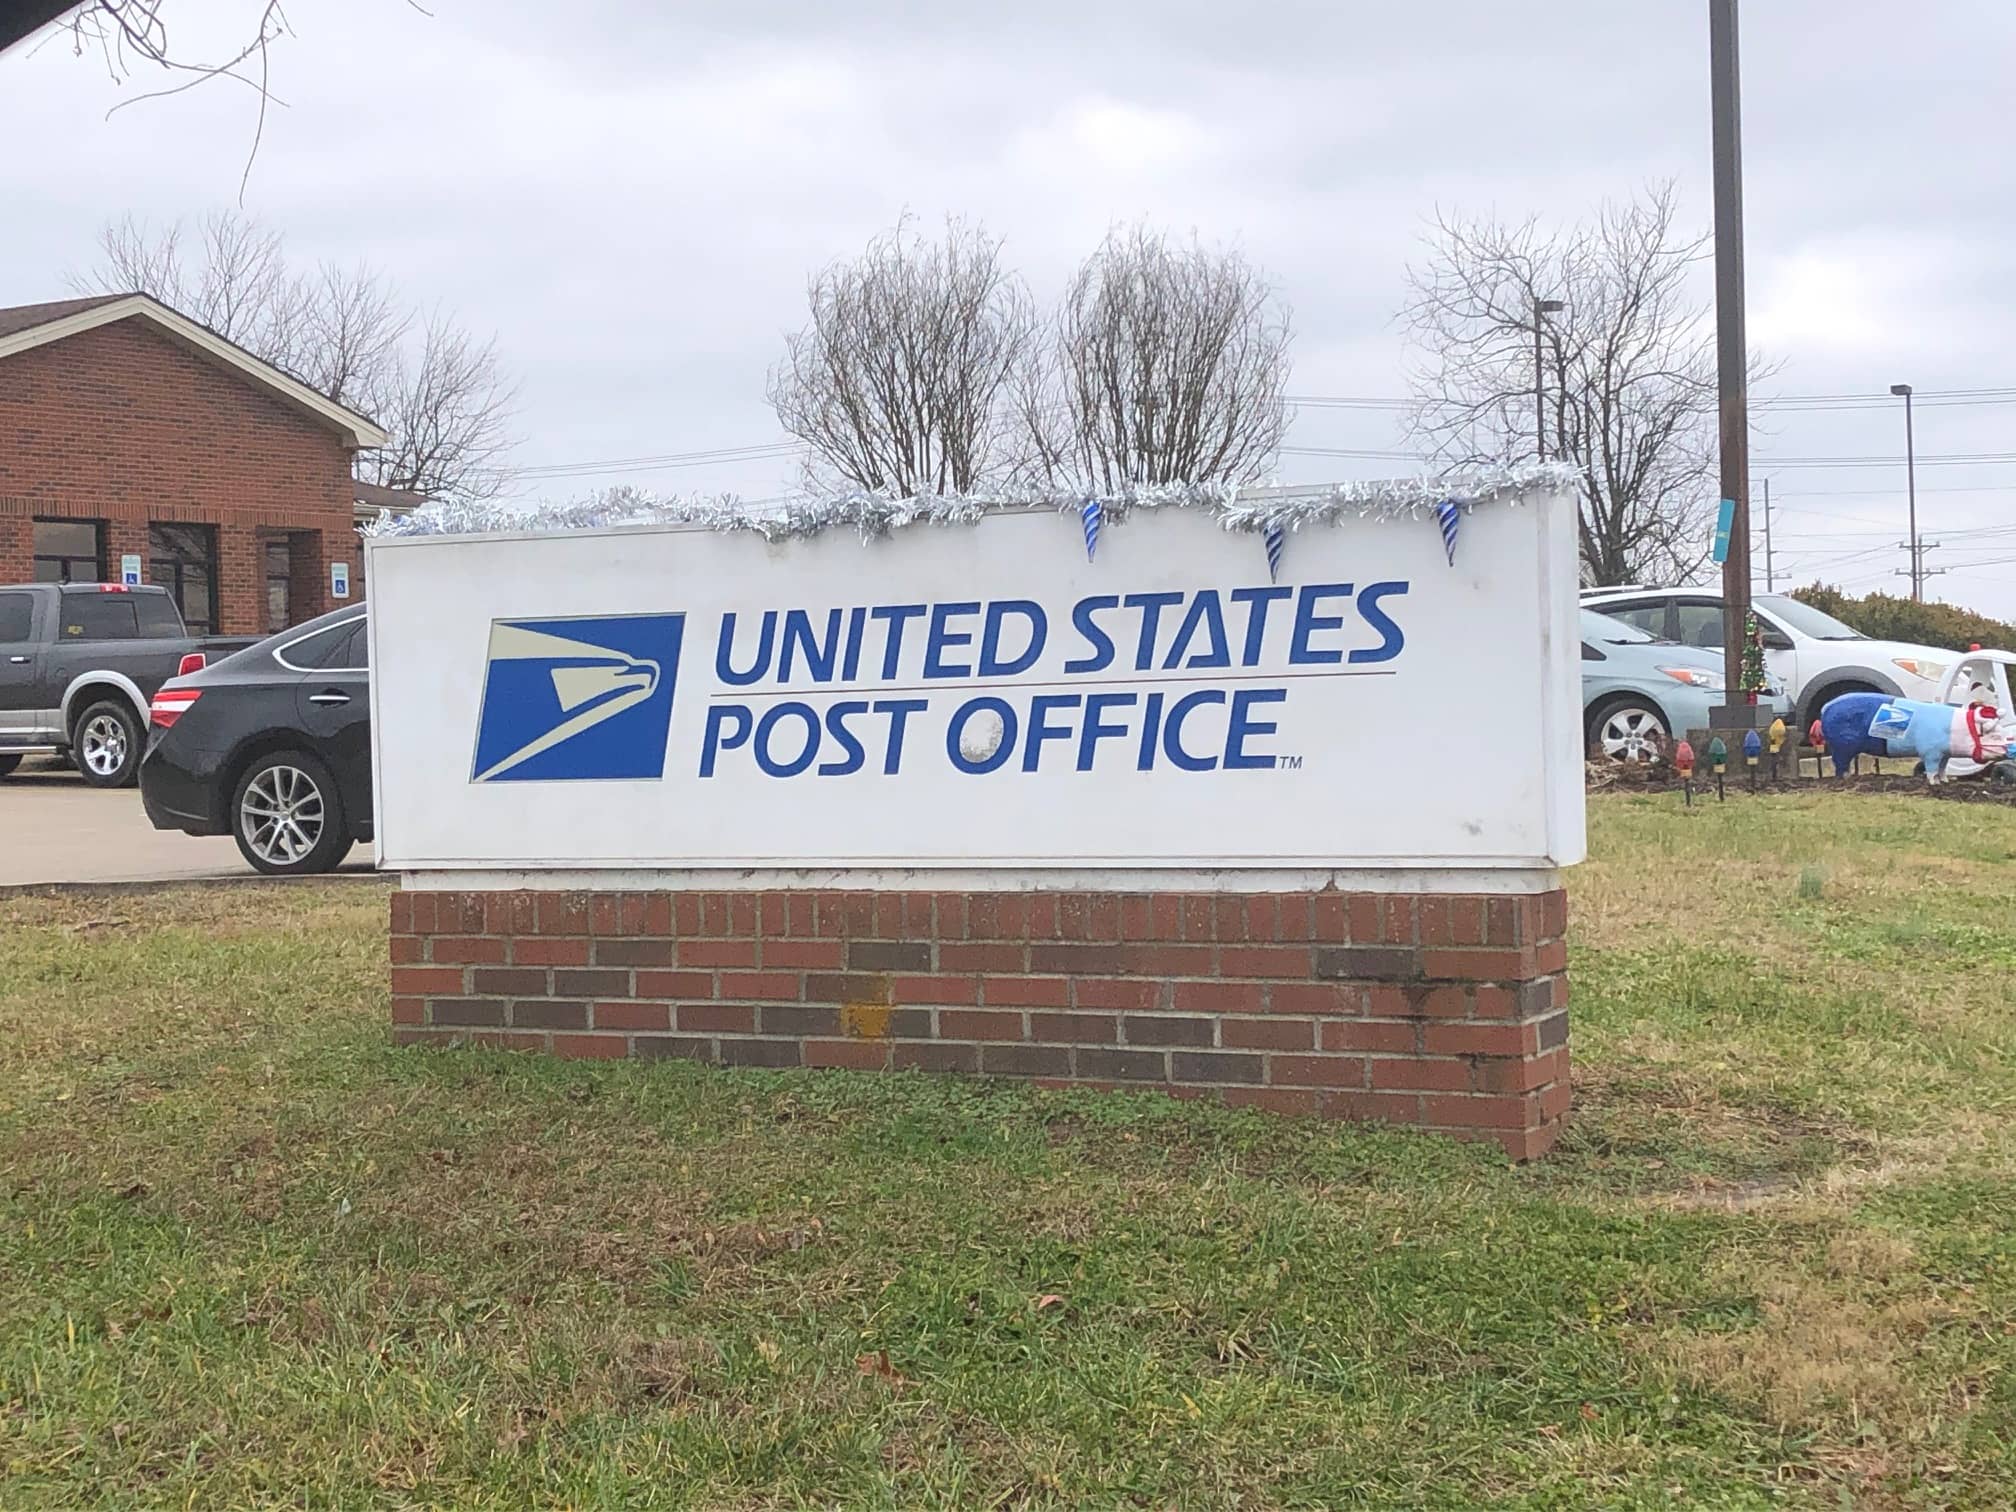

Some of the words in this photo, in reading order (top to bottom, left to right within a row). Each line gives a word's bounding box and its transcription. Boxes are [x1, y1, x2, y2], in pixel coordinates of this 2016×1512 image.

[715, 600, 1048, 686] UNITED
[1064, 581, 1409, 673] STATES
[698, 699, 929, 779] POST
[945, 688, 1287, 775] OFFICE
[1279, 756, 1303, 769] TM
